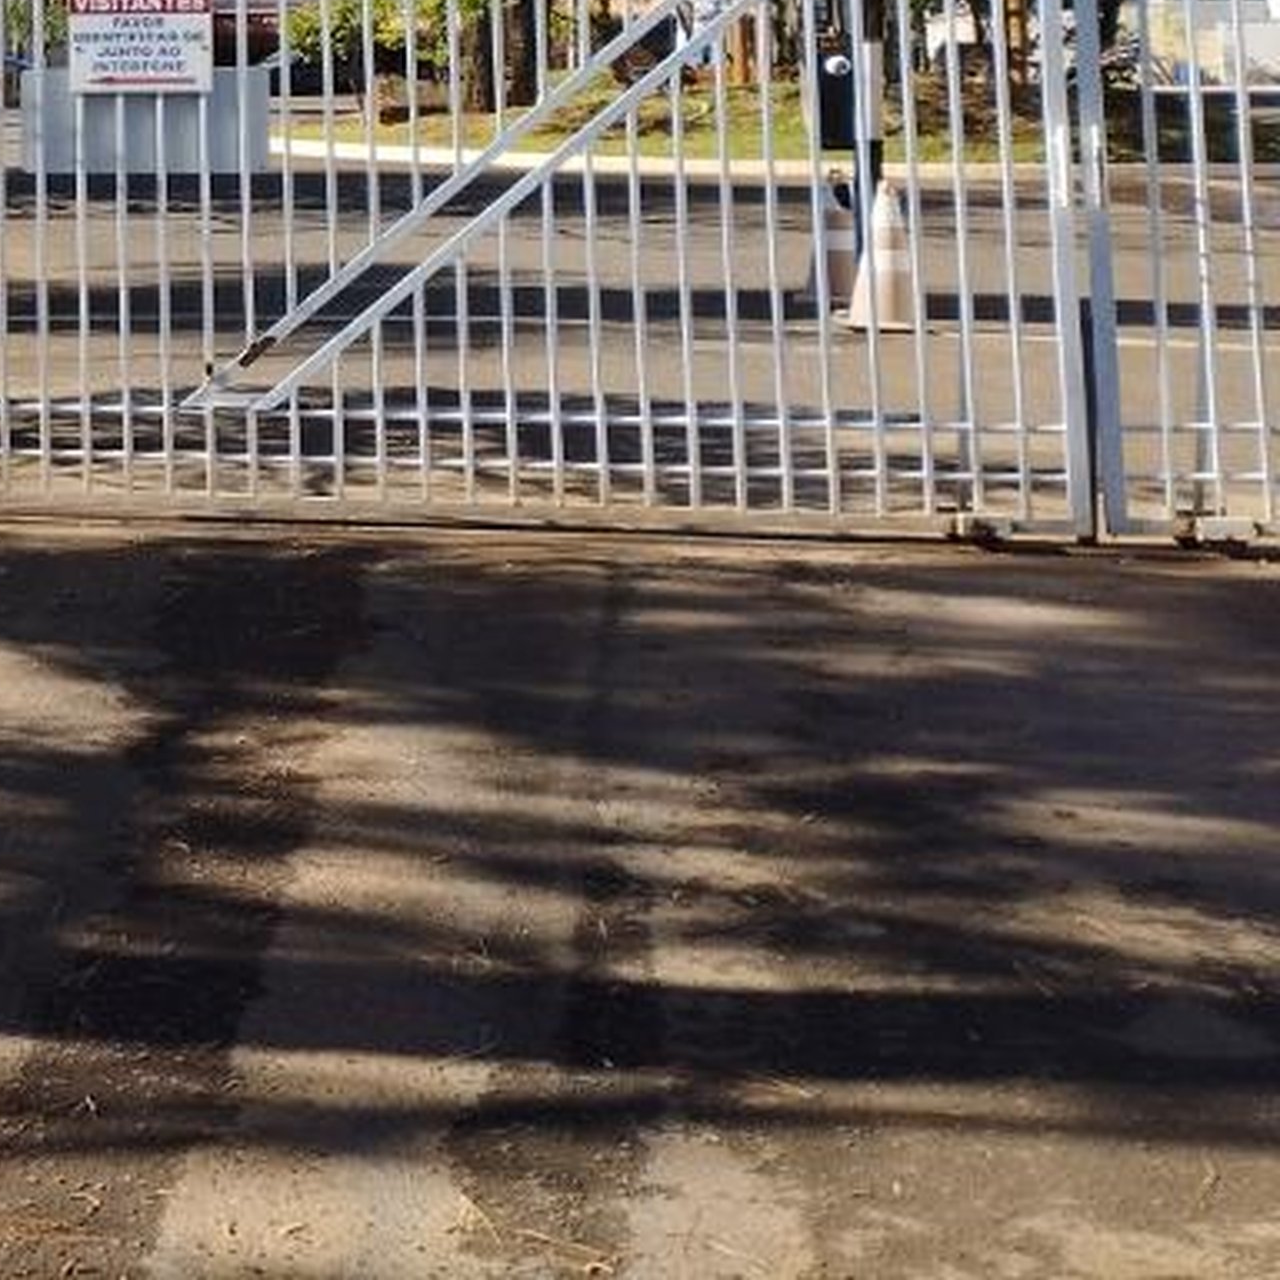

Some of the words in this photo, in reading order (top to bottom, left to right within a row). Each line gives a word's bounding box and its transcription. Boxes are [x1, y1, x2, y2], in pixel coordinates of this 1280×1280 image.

[112, 17, 164, 28] FAVOR
[96, 47, 153, 57] JUNTO
[158, 46, 181, 57] AO
